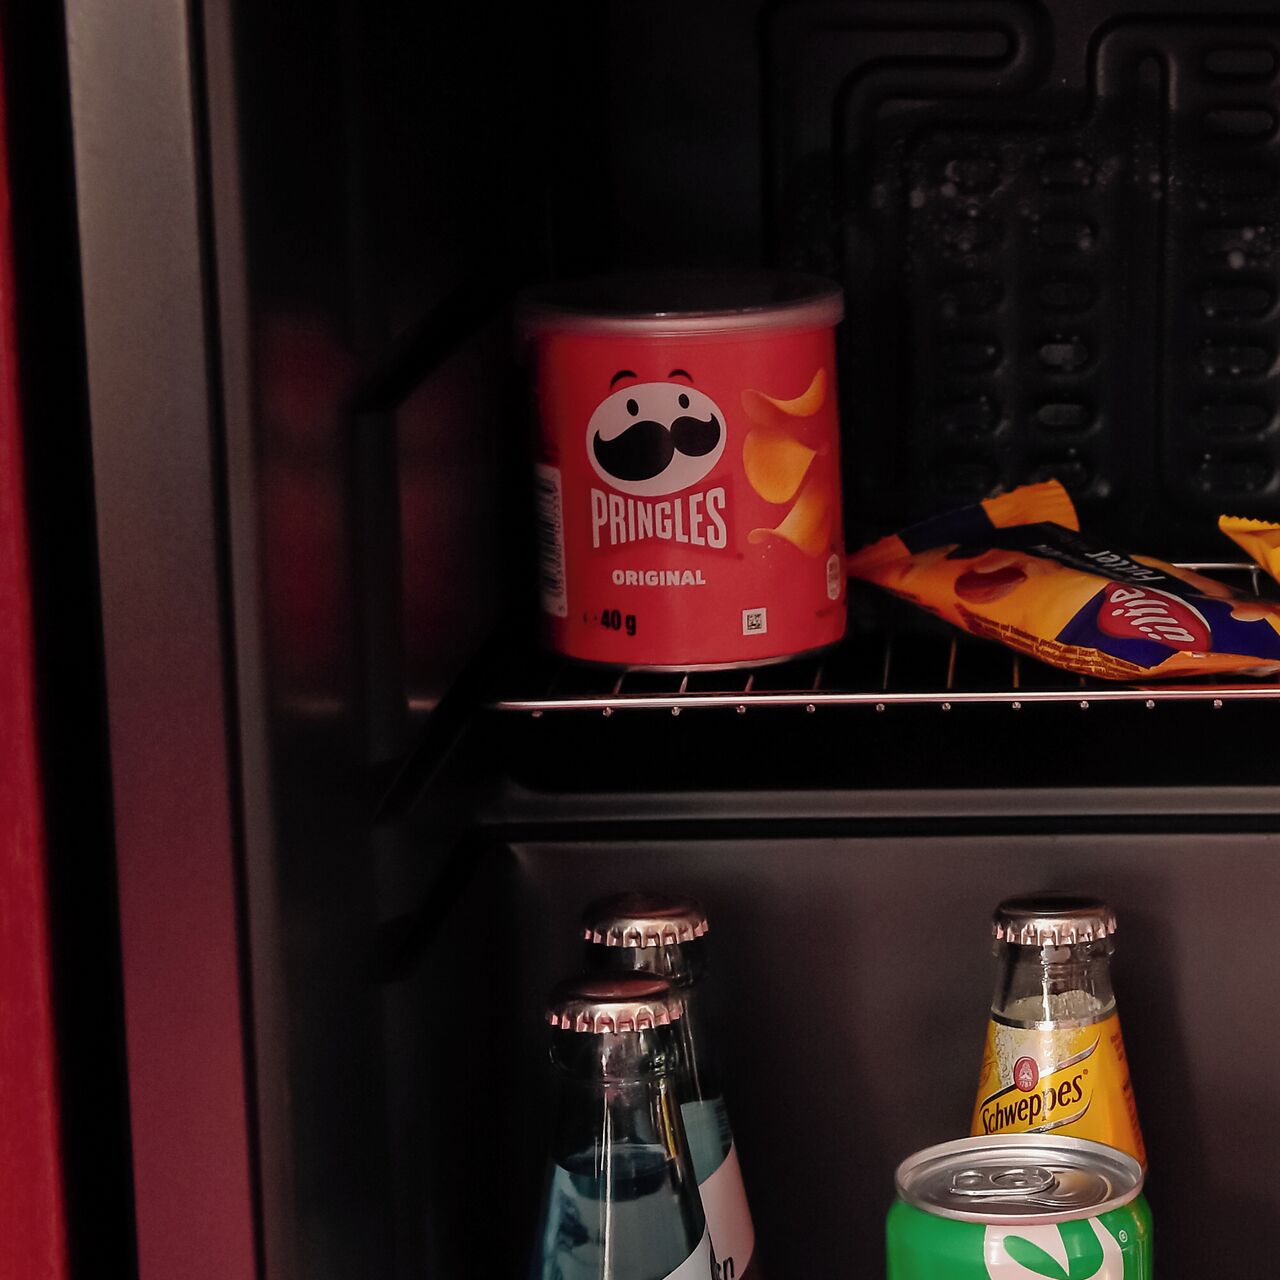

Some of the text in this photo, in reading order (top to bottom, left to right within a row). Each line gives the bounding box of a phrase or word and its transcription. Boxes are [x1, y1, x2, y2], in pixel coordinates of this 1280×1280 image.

[590, 486, 728, 549] PRINGLES
[611, 569, 707, 586] ORIGINAL
[601, 609, 637, 636] 40 g
[981, 1073, 1083, 1135] Schweppes
